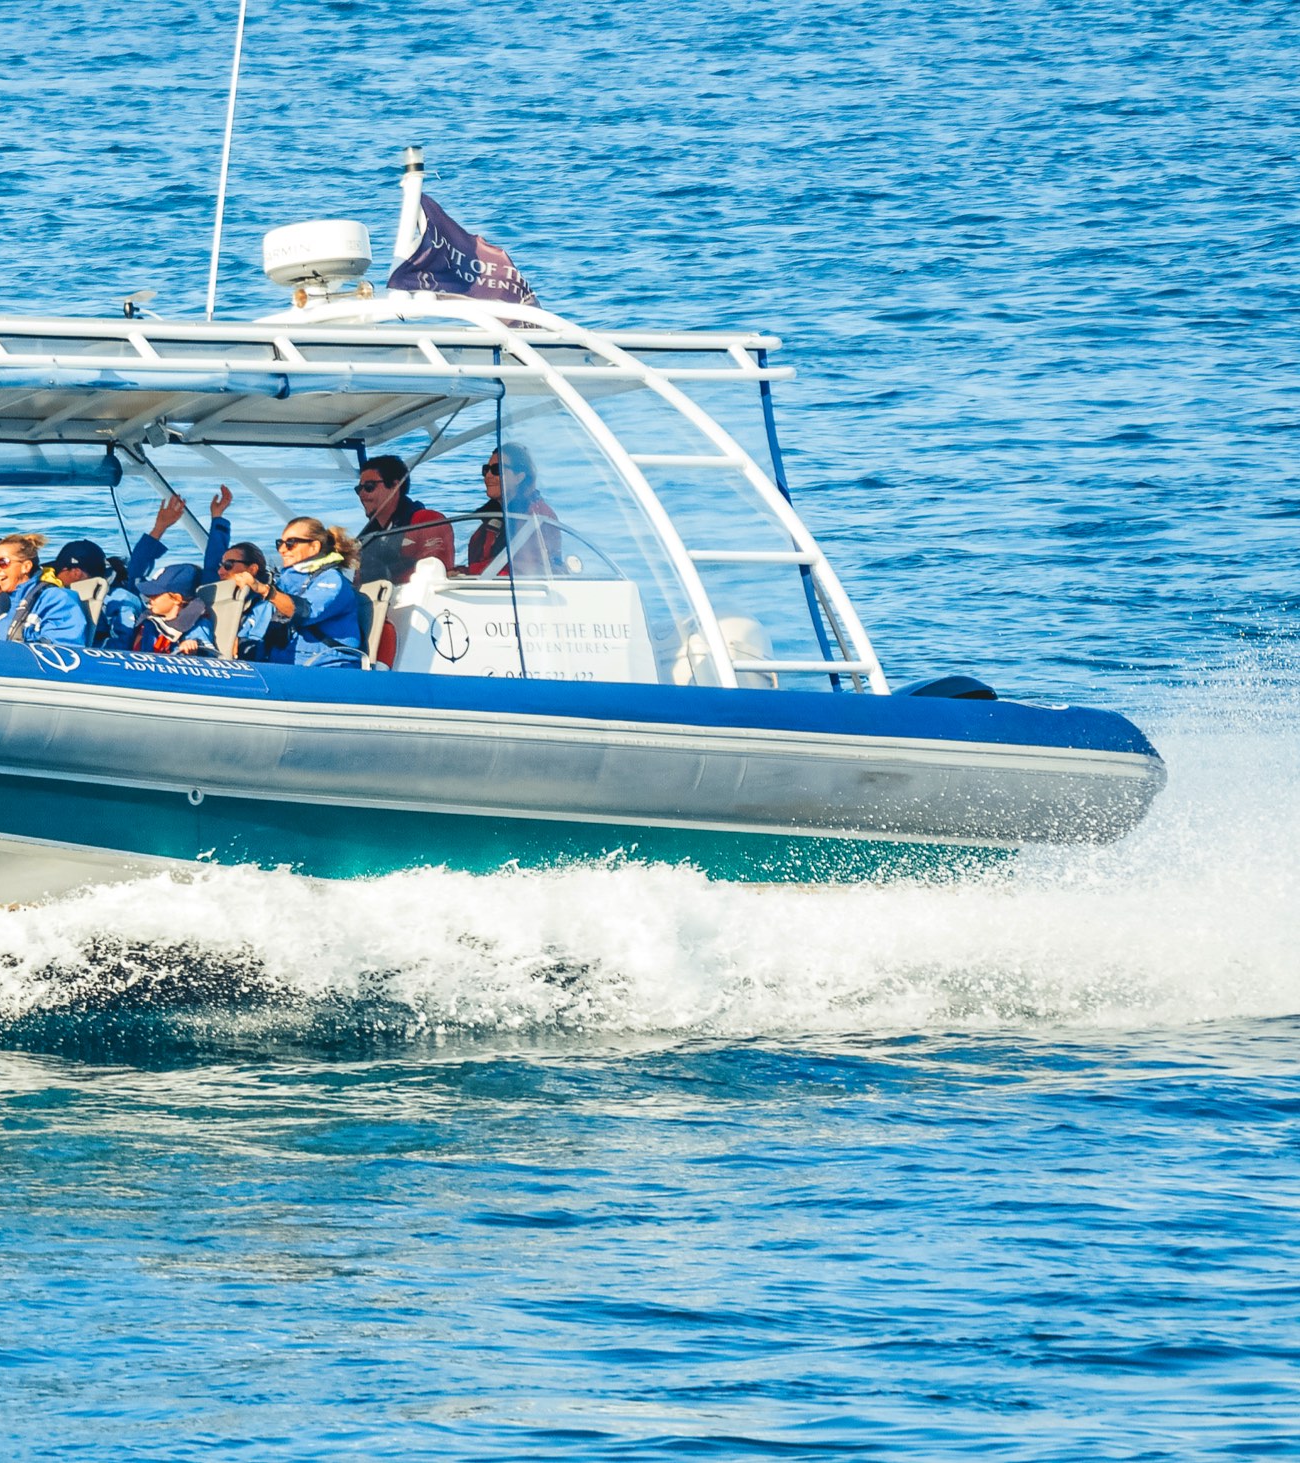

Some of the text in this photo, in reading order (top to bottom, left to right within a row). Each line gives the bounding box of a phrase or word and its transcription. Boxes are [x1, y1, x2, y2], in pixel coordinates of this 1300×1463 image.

[470, 259, 498, 277] OF
[526, 622, 548, 638] OF
[552, 623, 587, 639] THE
[594, 623, 632, 640] BLUE
[516, 641, 609, 654] DVENTURES
[82, 648, 254, 672] OUT OF THE BLUE
[124, 661, 231, 680] ADVENTURES
